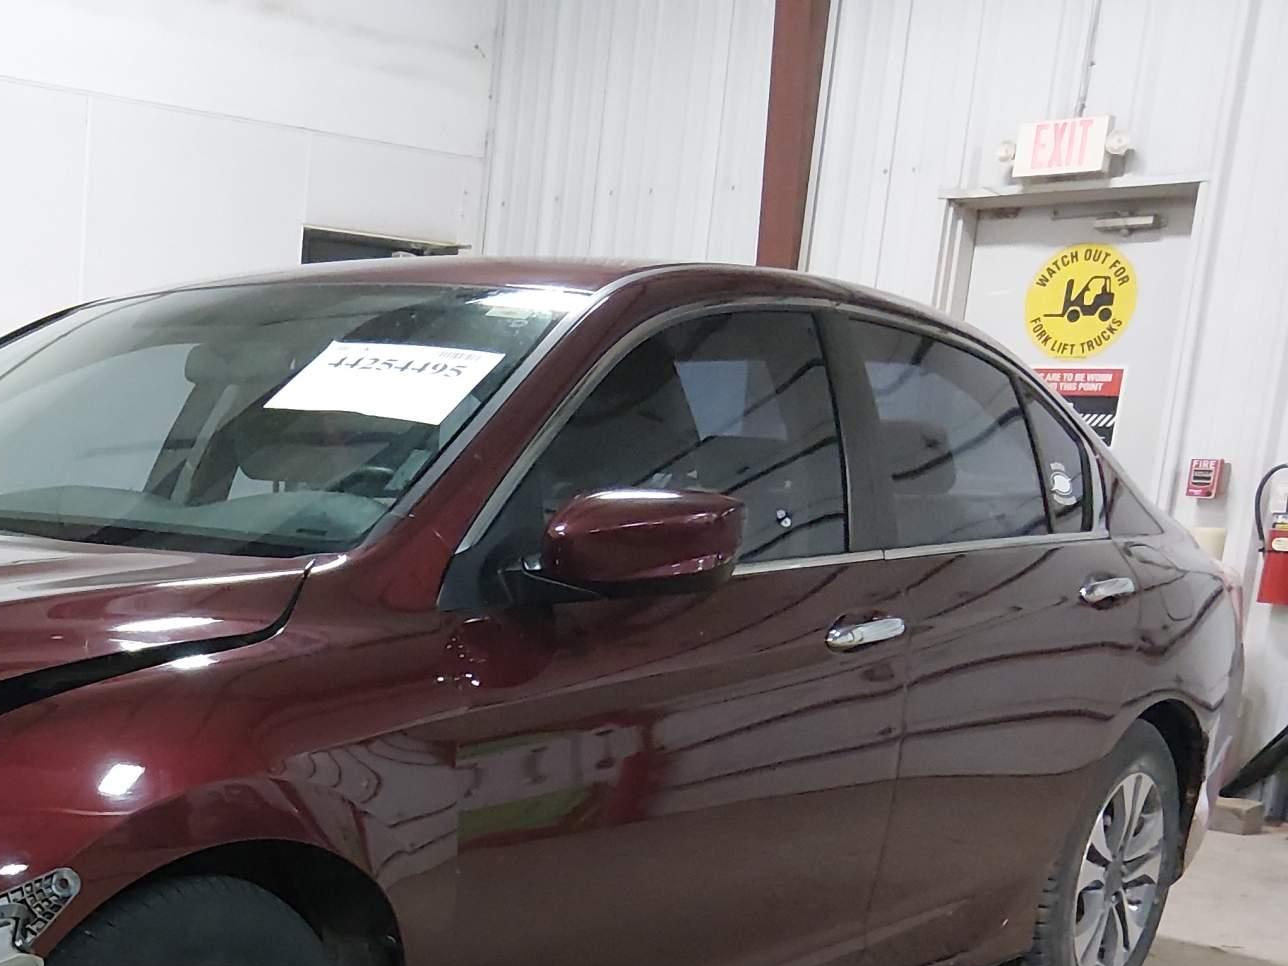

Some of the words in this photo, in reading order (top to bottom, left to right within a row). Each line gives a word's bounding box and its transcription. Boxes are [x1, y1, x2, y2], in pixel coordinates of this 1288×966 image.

[1031, 119, 1094, 169] EXIT
[1036, 250, 1079, 288] WATCH
[1084, 248, 1111, 265] OUT
[1109, 259, 1130, 287] FOR
[1030, 317, 1053, 346] FORK
[1050, 340, 1076, 355] LIFT
[1080, 318, 1123, 354] TRUCKS
[328, 356, 467, 378] 44254495
[1192, 460, 1216, 468] FIRE
